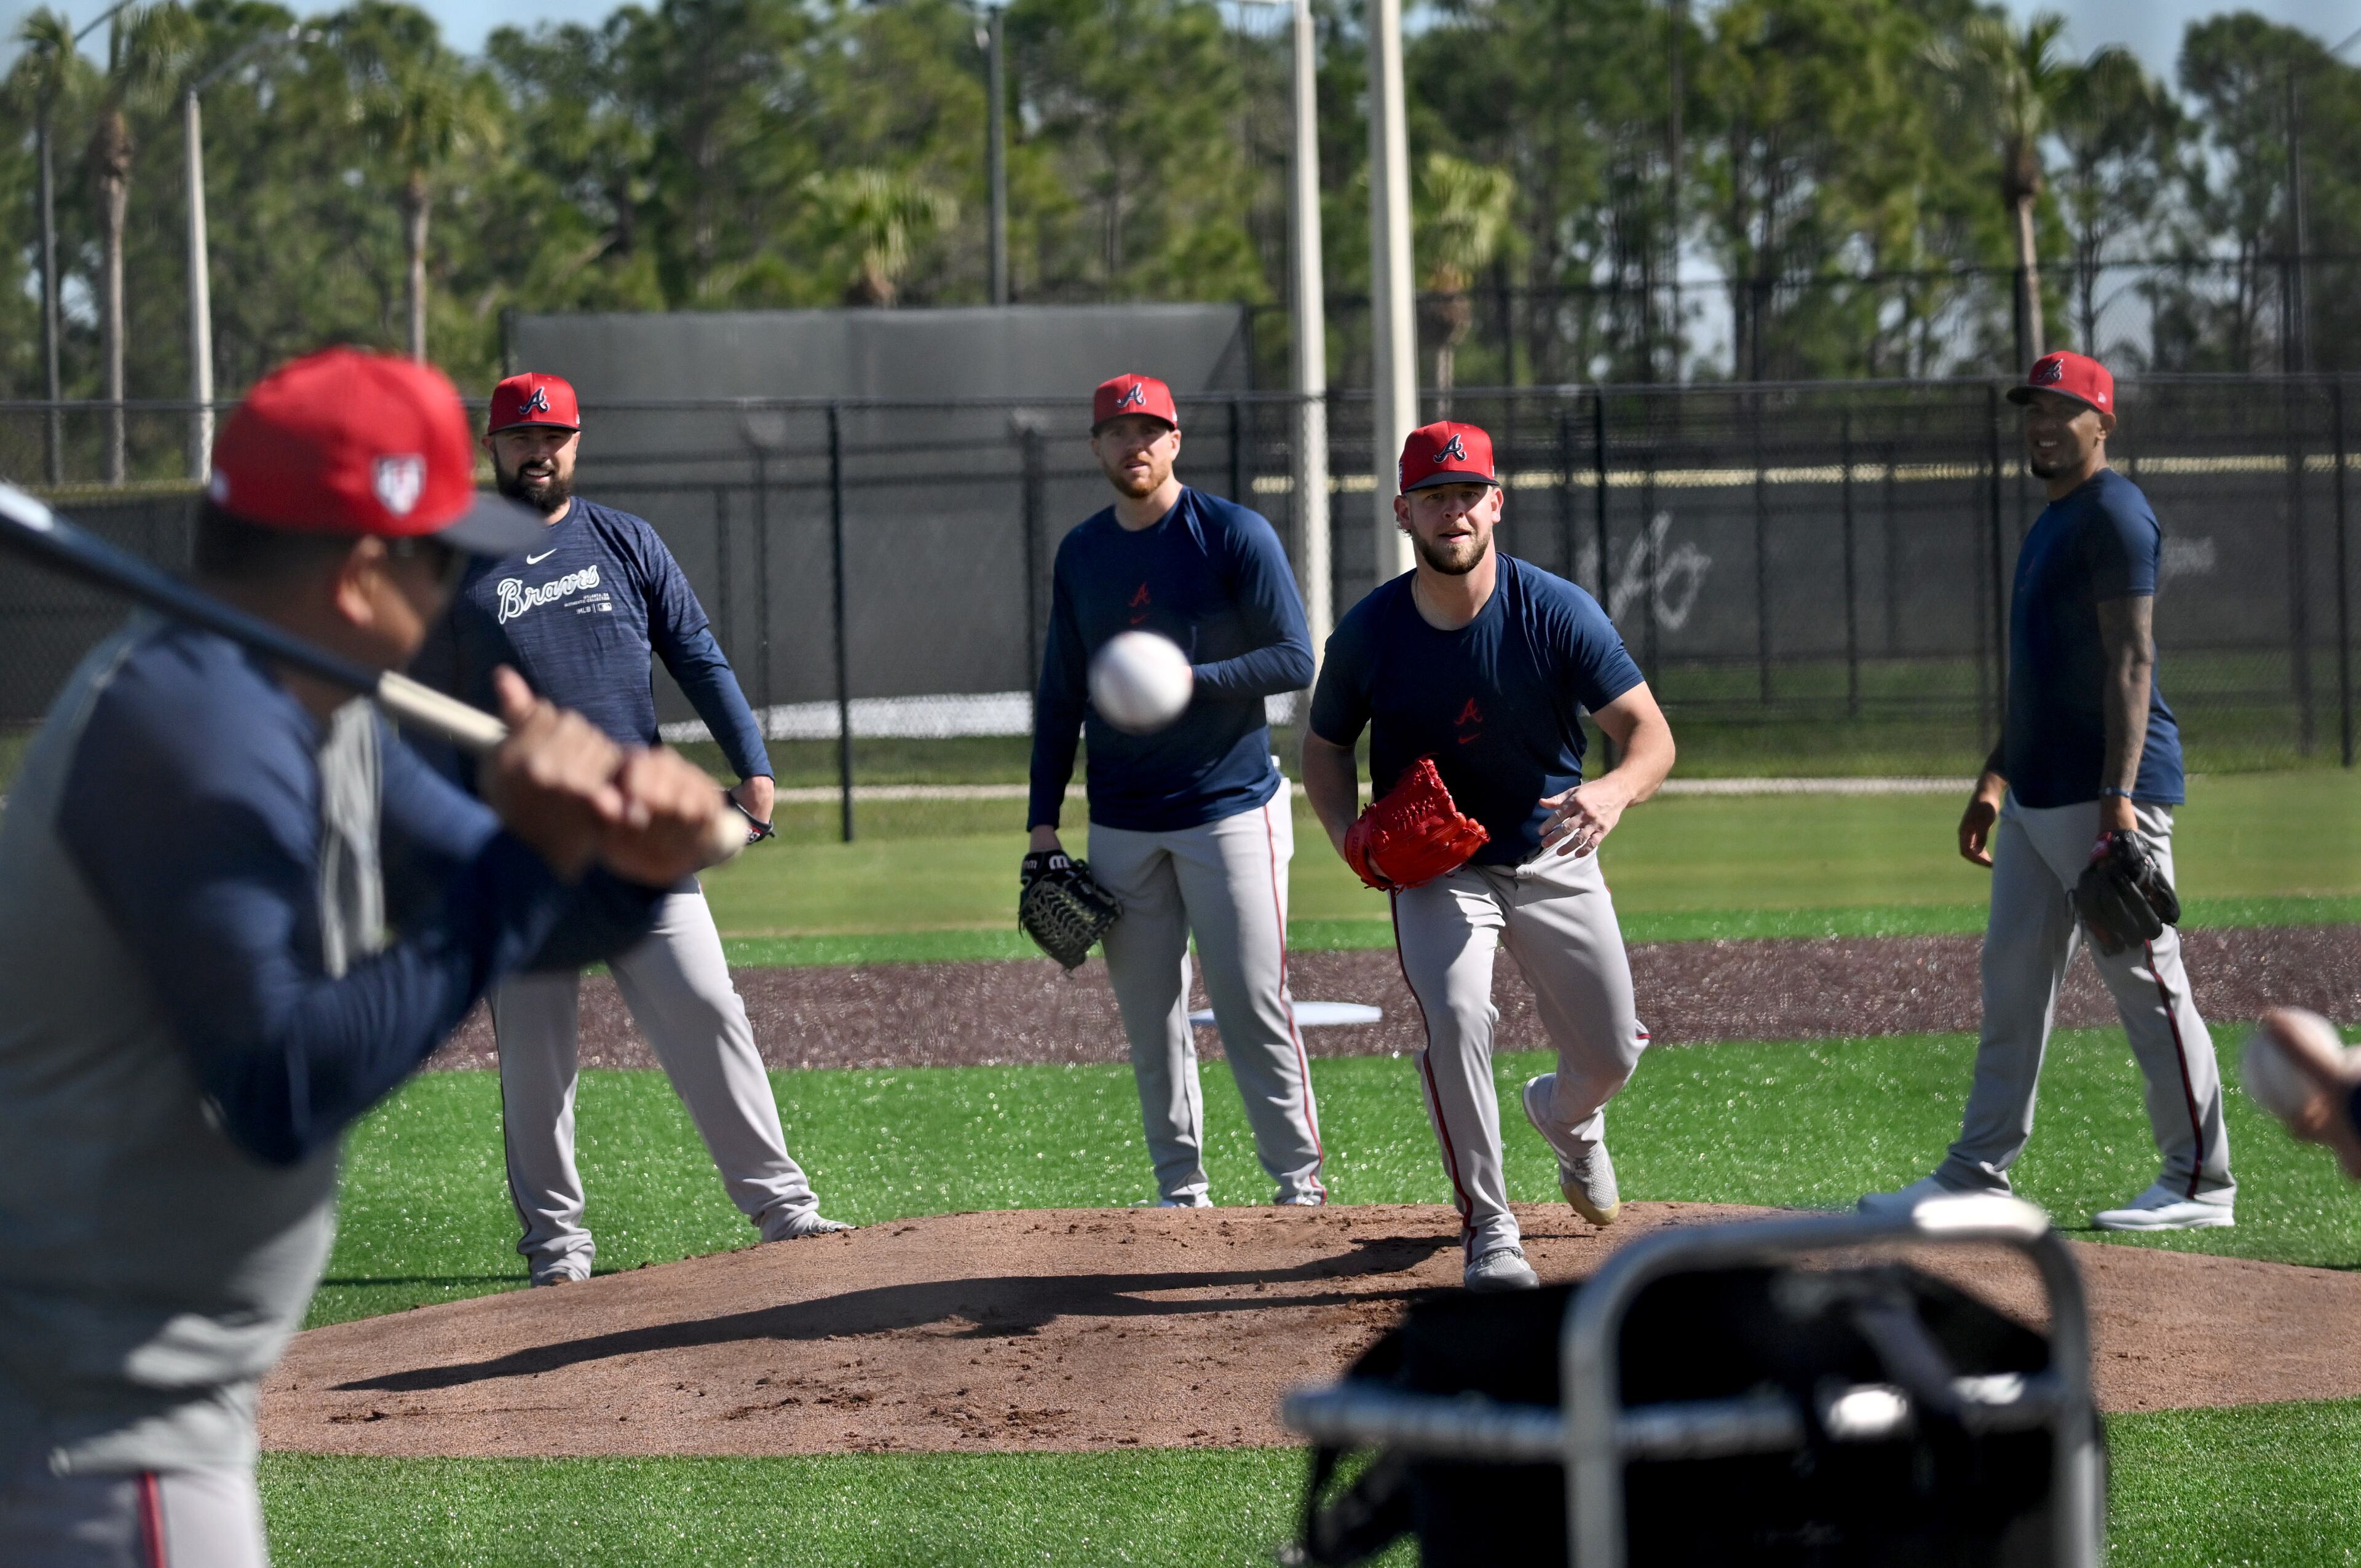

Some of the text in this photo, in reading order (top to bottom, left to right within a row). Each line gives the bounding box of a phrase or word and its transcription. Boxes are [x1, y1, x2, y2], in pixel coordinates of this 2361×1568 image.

[519, 386, 551, 414] A
[1116, 382, 1147, 408] A
[1433, 433, 1466, 463] A
[497, 564, 600, 625] Braves
[1453, 696, 1483, 725] A
